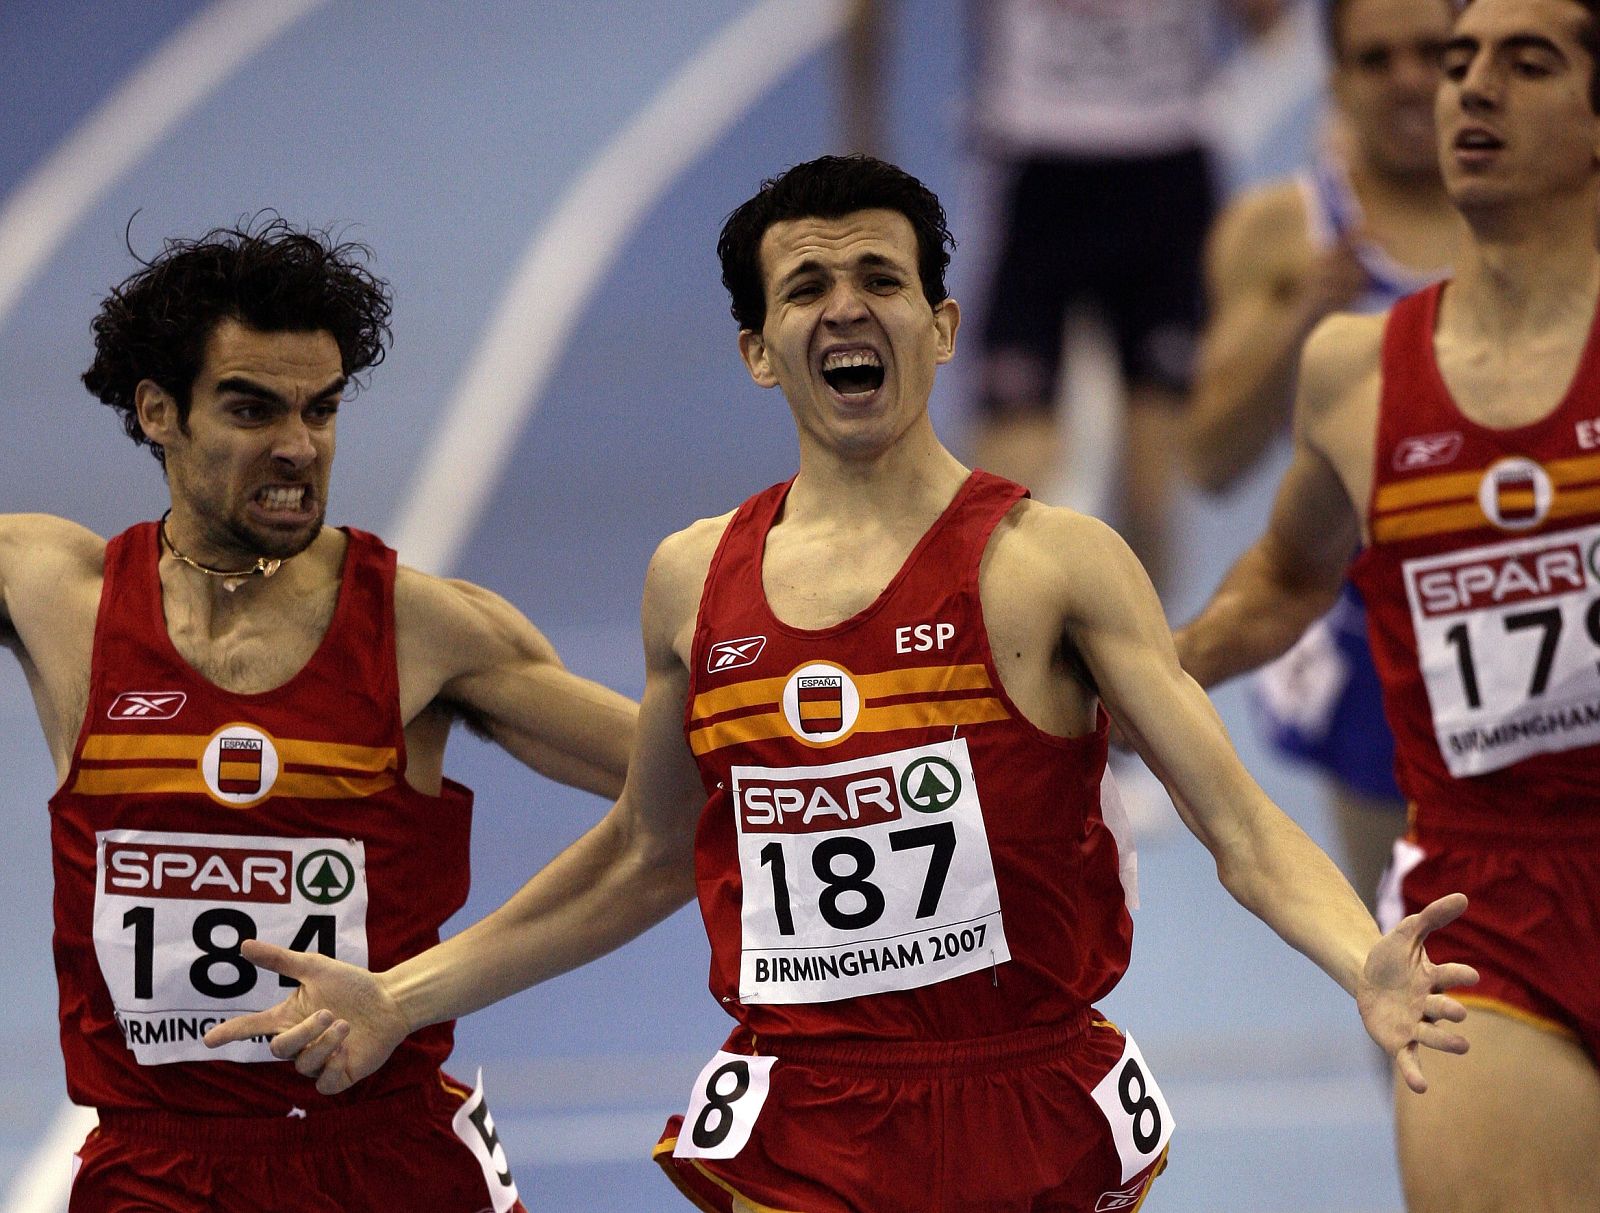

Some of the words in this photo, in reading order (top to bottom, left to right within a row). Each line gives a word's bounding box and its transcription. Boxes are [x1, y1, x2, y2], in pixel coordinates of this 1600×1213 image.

[1421, 553, 1581, 614] SPAR
[895, 624, 954, 653] ESP
[801, 677, 837, 688] ESPAÑA
[224, 740, 259, 750] ESPAÑA
[745, 777, 895, 825] SPAR
[112, 851, 286, 896] SPAR
[760, 821, 957, 936] 187
[755, 940, 924, 983] BIRMINGHAM
[930, 924, 988, 962] 2007
[692, 1060, 750, 1149] 8
[1118, 1058, 1162, 1155] 8
